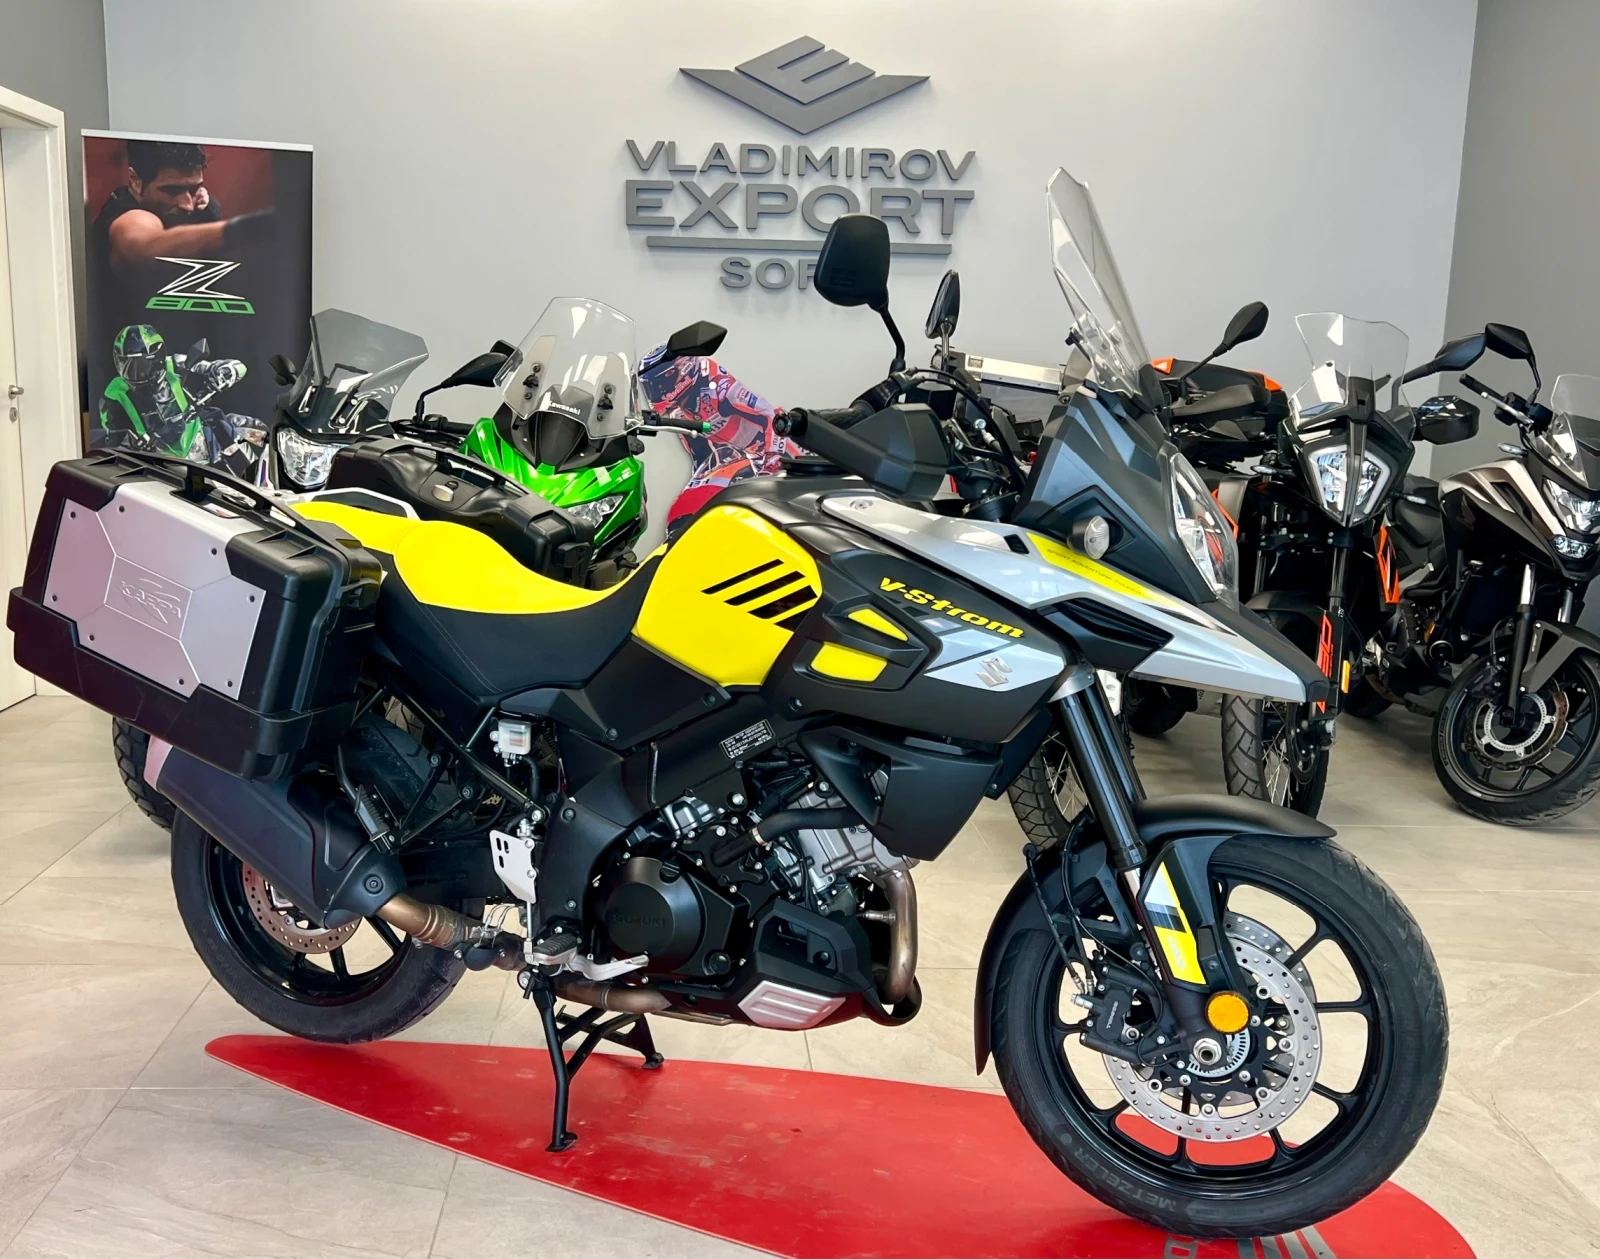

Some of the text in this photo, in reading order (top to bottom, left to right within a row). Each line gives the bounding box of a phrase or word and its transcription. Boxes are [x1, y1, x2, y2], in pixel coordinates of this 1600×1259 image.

[625, 138, 977, 181] VLADIMIROV
[625, 179, 976, 236] EXPORT
[719, 255, 819, 290] SOF
[144, 296, 256, 315] 800
[879, 576, 1025, 639] V-Strom
[1074, 1147, 1177, 1213] METZELER
